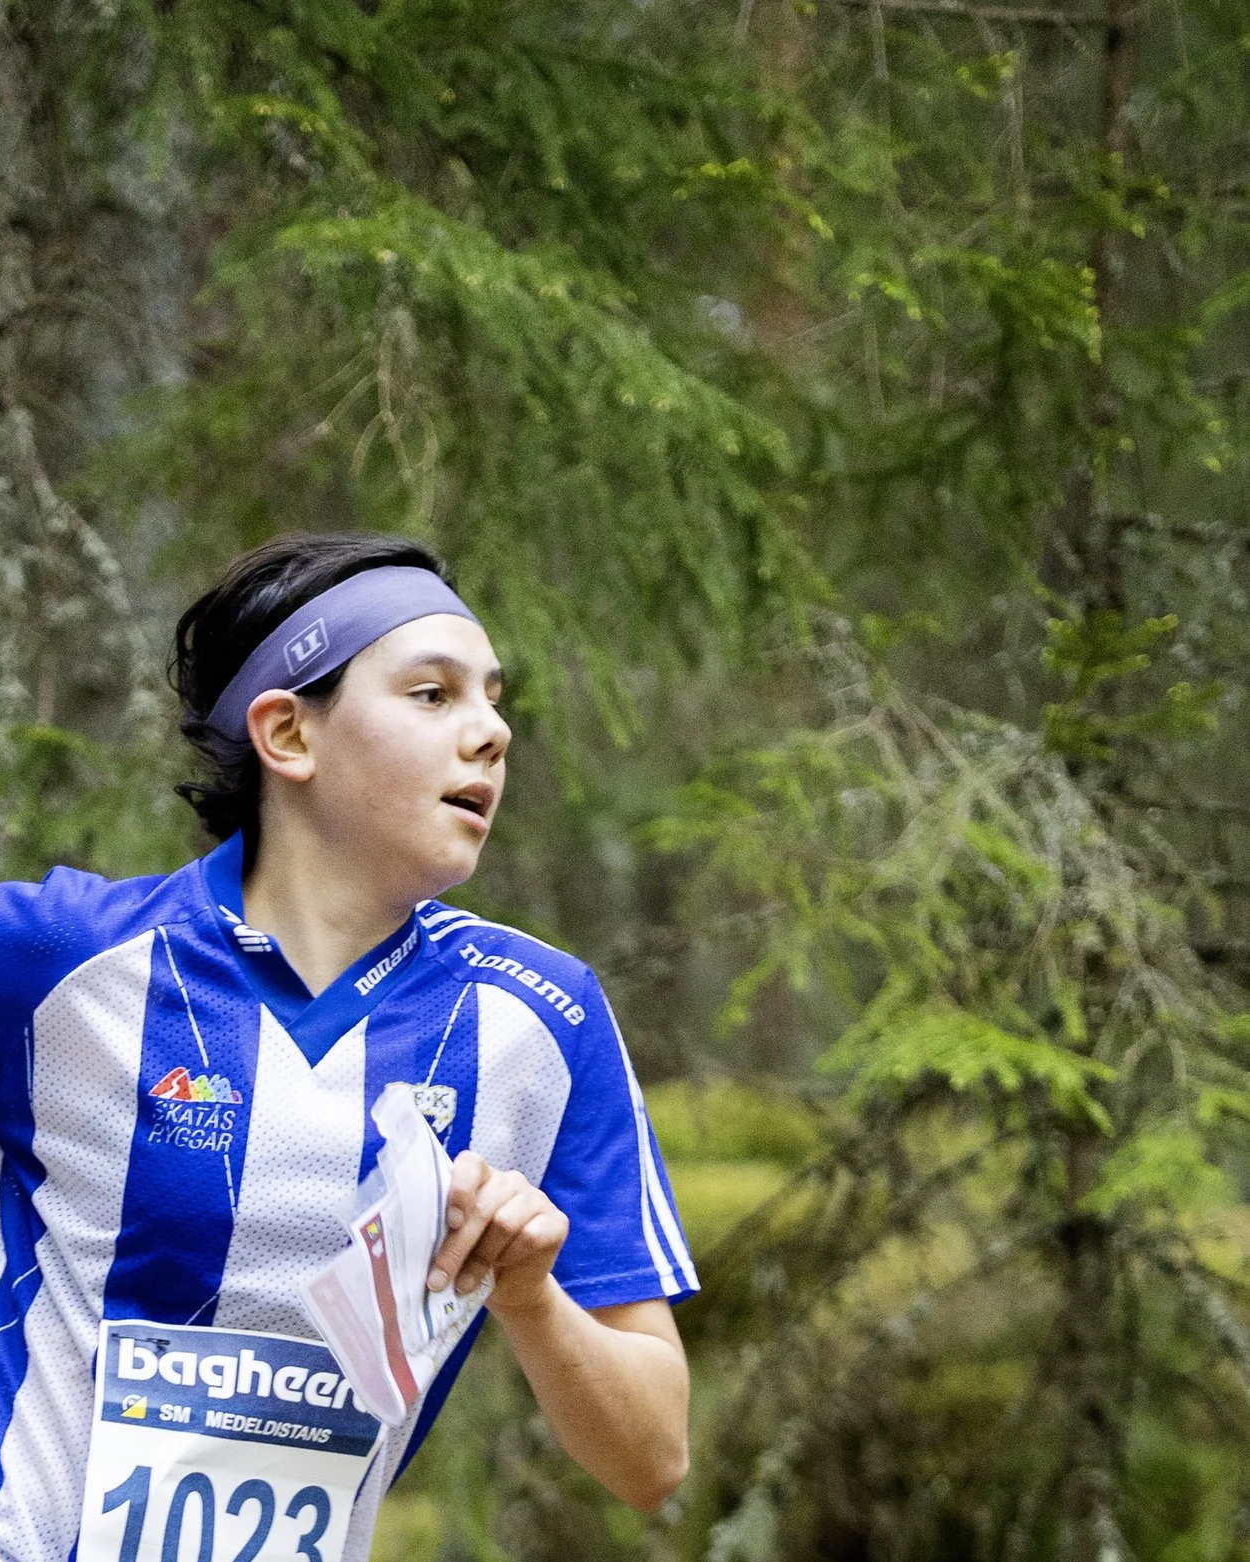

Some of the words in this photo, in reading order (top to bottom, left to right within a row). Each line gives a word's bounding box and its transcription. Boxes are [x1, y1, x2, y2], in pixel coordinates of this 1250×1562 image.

[458, 942, 586, 1026] noname
[159, 1403, 191, 1424] SM
[205, 1410, 333, 1444] MEDELDISTANS
